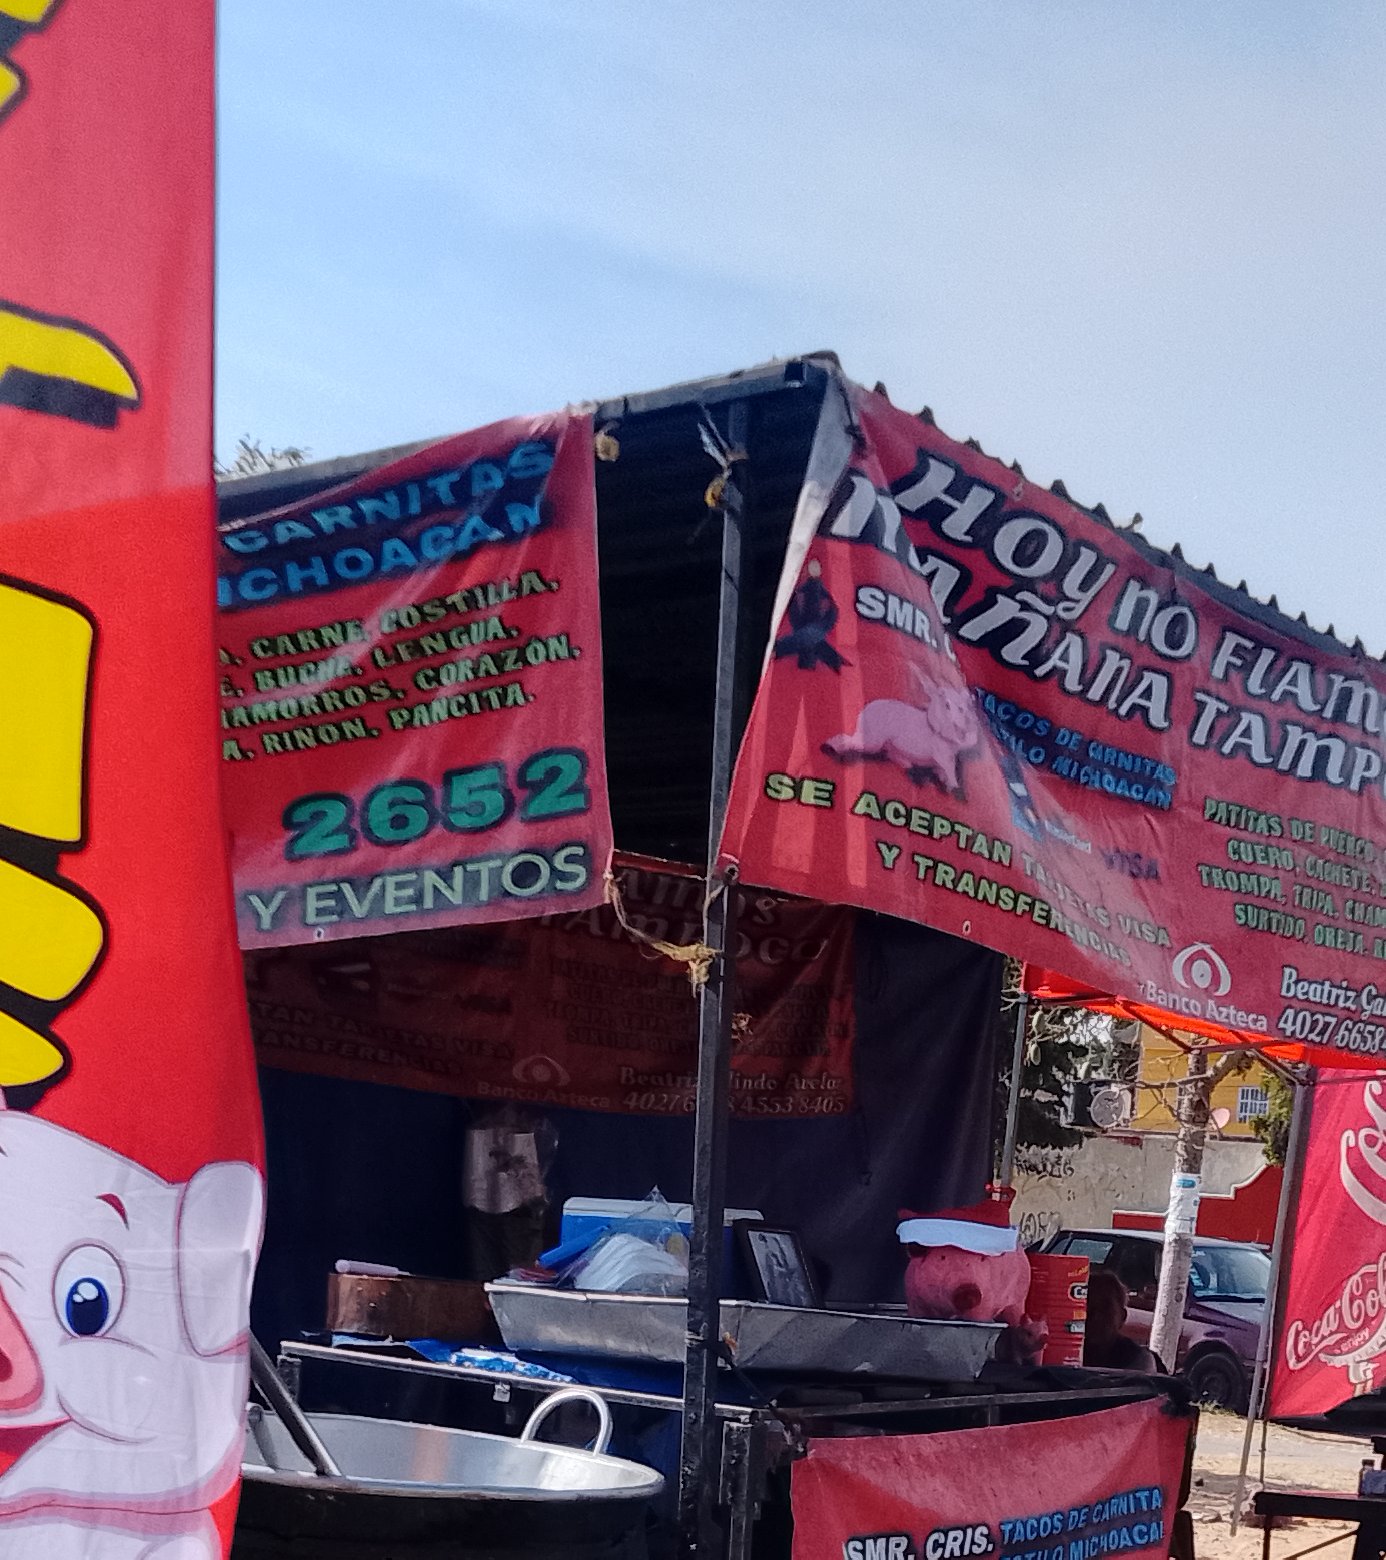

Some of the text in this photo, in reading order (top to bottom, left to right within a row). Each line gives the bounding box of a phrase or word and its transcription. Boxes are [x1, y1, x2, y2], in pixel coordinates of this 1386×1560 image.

[222, 441, 556, 553] CARNITAS
[216, 493, 541, 607] ICHOACAN
[856, 586, 938, 649] SMR.
[1054, 727, 1083, 750] DE
[286, 750, 589, 858] 2652
[1203, 797, 1284, 837] PATITAS
[1289, 819, 1315, 843] DE
[765, 773, 835, 807] SE
[854, 791, 1012, 867] ACEPTAN
[1116, 912, 1172, 948] VISA
[877, 842, 901, 869] Y
[248, 847, 587, 929] Y EVENTOS
[1145, 980, 1268, 1032] Banco Azteca
[1280, 966, 1357, 1011] Beatriz
[1277, 1007, 1338, 1045] 4027
[999, 1513, 1063, 1546] TACOS
[1067, 1506, 1088, 1532] DE
[1092, 1486, 1164, 1524] CARNITA
